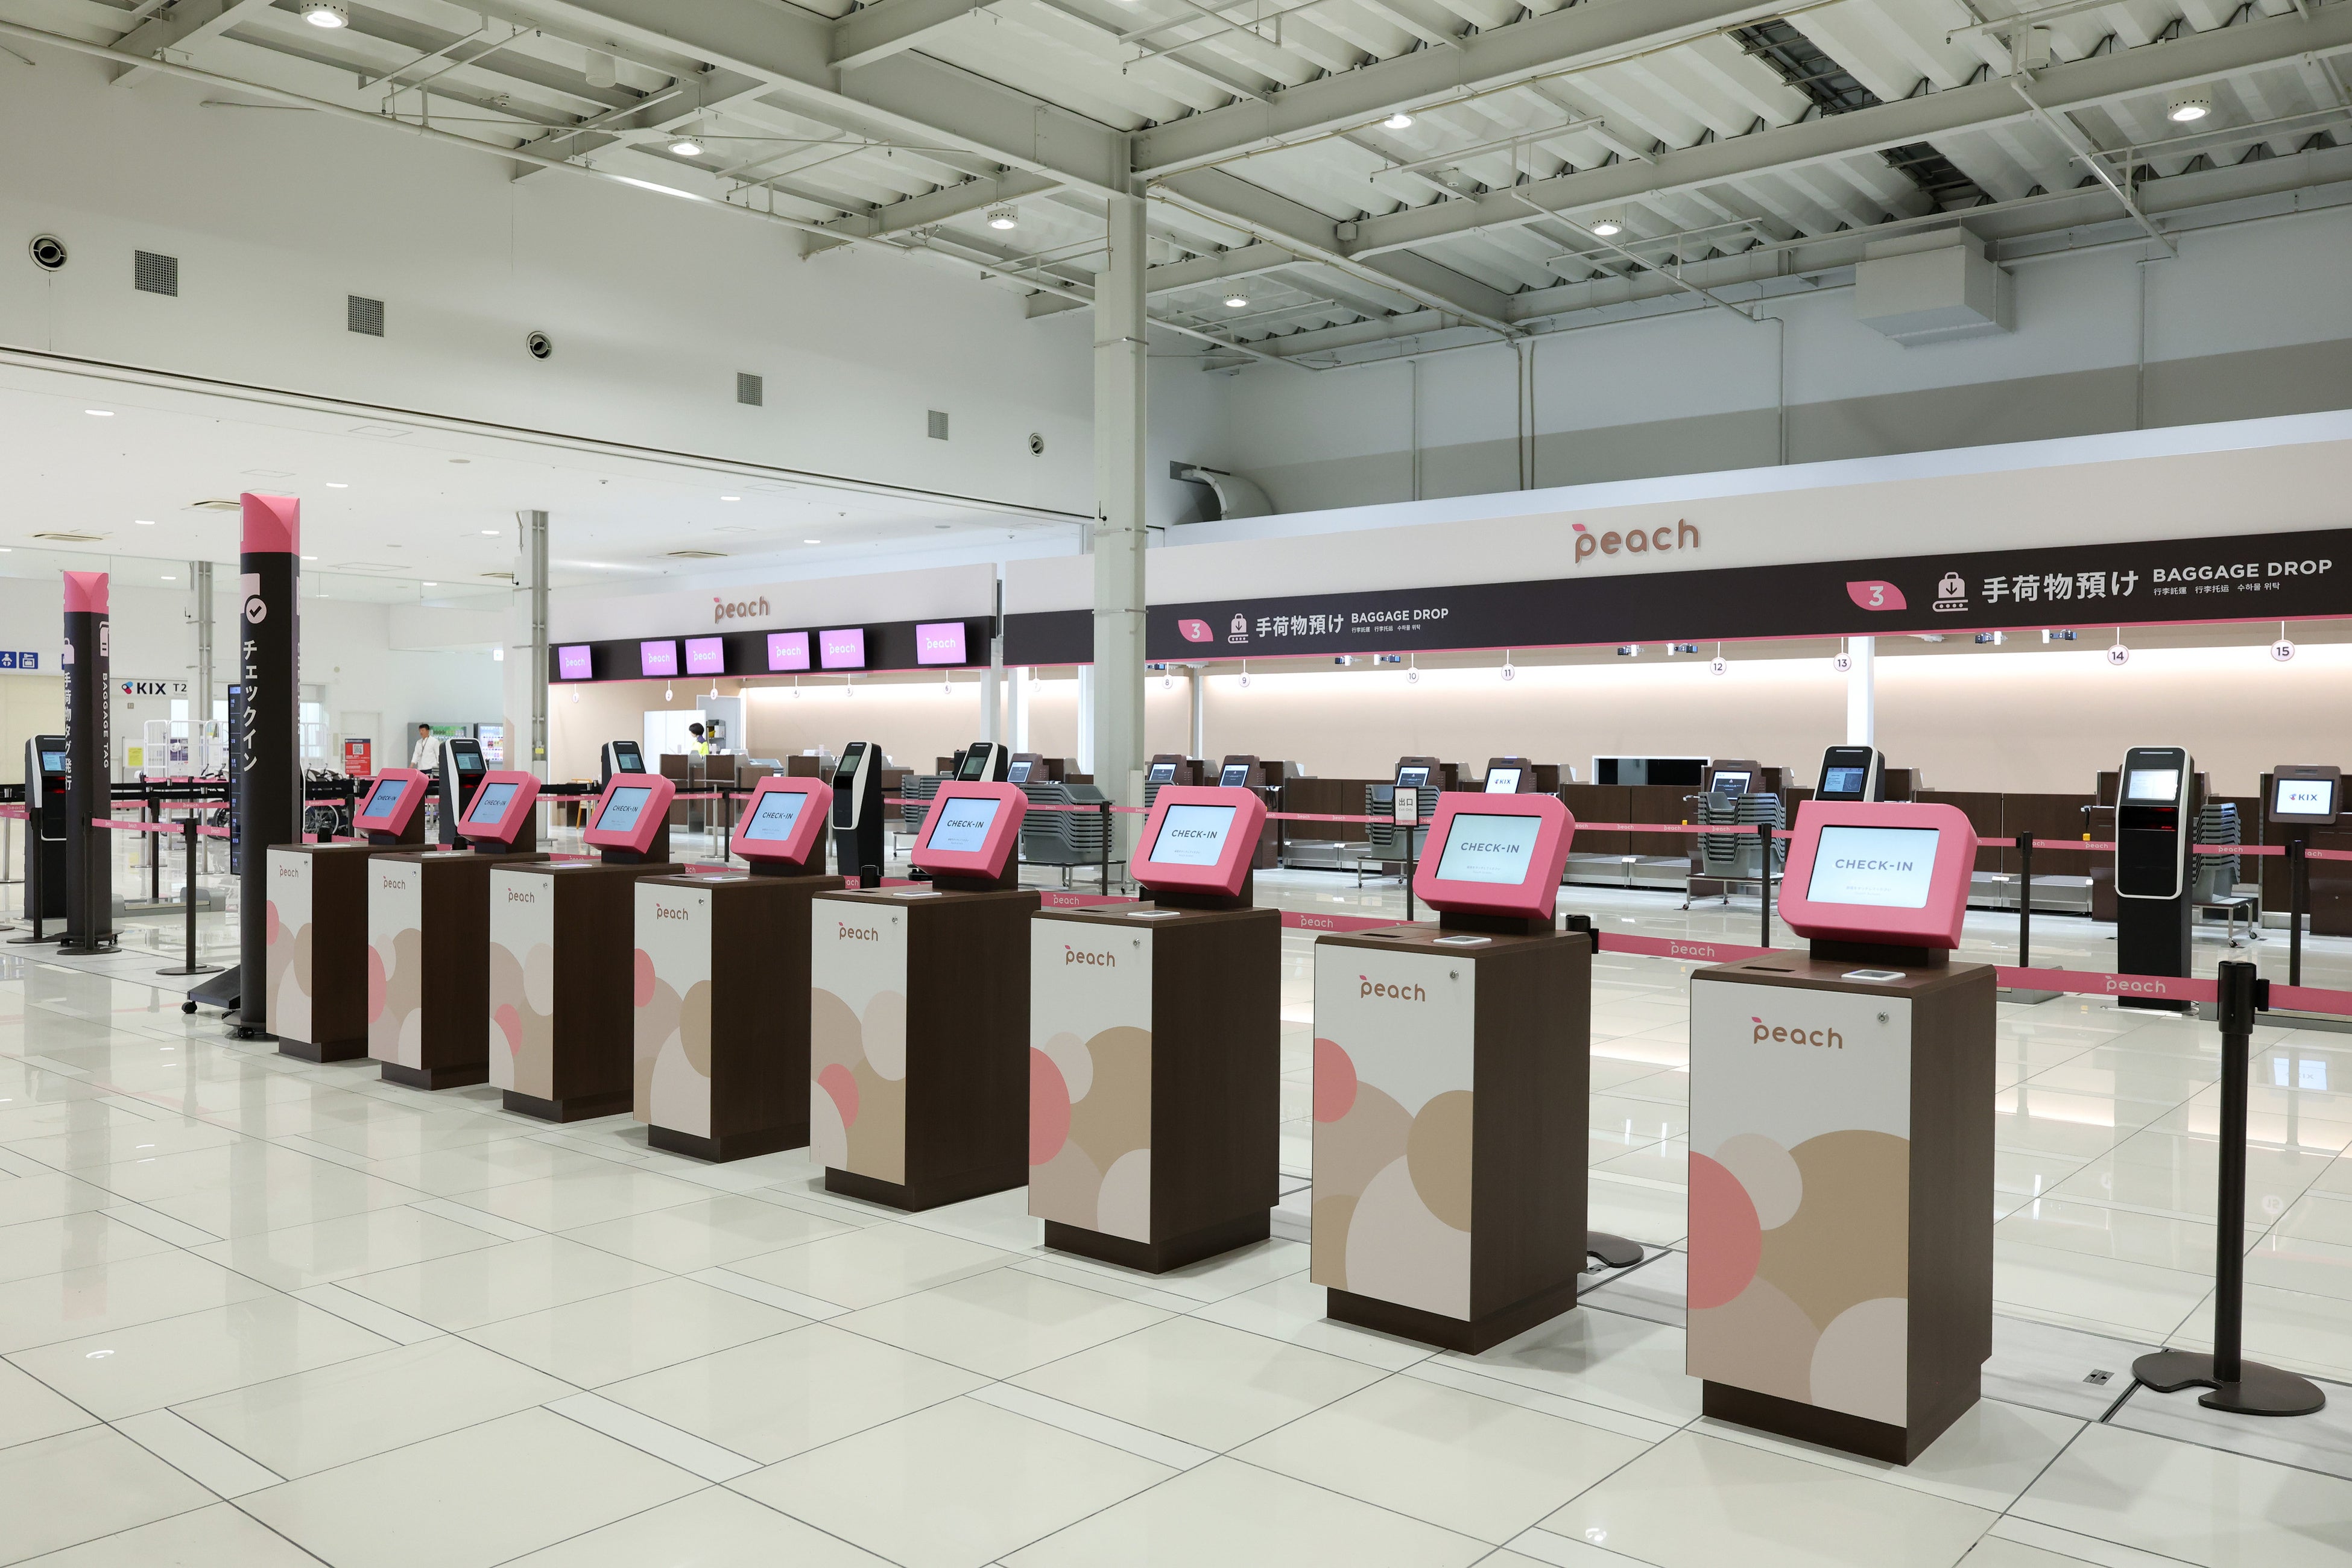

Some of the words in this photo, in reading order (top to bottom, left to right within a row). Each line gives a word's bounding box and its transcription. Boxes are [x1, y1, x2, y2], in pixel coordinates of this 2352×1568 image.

[1572, 518, 1699, 564] peach
[2153, 563, 2259, 583] BAGGAGE
[2268, 559, 2333, 577] DROP
[1982, 571, 2139, 603] 手荷物預け
[2154, 586, 2187, 596] 行李託運
[2195, 584, 2229, 594] 行李托运
[2237, 583, 2261, 592] 수하물
[2264, 582, 2280, 590] 위탁
[1868, 586, 1885, 606] 3
[713, 595, 770, 624] peach
[1351, 610, 1409, 623] BAGGAGE
[1414, 608, 1449, 620] DROP
[1191, 623, 1201, 639] 3
[1256, 614, 1344, 637] 手荷物預け
[829, 643, 856, 655] peach
[926, 637, 956, 650] peach
[693, 650, 716, 662] peach
[776, 646, 801, 658] peach
[2111, 651, 2124, 660] 14
[2277, 646, 2289, 656] 15
[565, 657, 585, 668] peach
[648, 653, 670, 665] peach
[137, 682, 166, 695] KIX
[173, 683, 187, 692] T2
[243, 639, 258, 773] チェックイン
[1399, 798, 1413, 806] 出口
[947, 820, 984, 829] CHECK-IN
[1171, 829, 1218, 839] CHECK-IN
[1461, 842, 1520, 853] CHECK-IN
[280, 865, 299, 878] peach
[1835, 859, 1913, 871] CHECK-IN
[383, 876, 406, 890] peach
[846, 878, 859, 887] ach
[508, 888, 534, 903] peach
[1053, 894, 1080, 905] peach
[656, 903, 688, 920] peach
[1300, 915, 1333, 928] peach
[838, 922, 878, 941] peach
[1064, 944, 1115, 967] peach
[1670, 941, 1715, 957] peach
[1359, 975, 1425, 1002] peach
[2105, 975, 2166, 994] peach
[1751, 1017, 1842, 1049] peach
